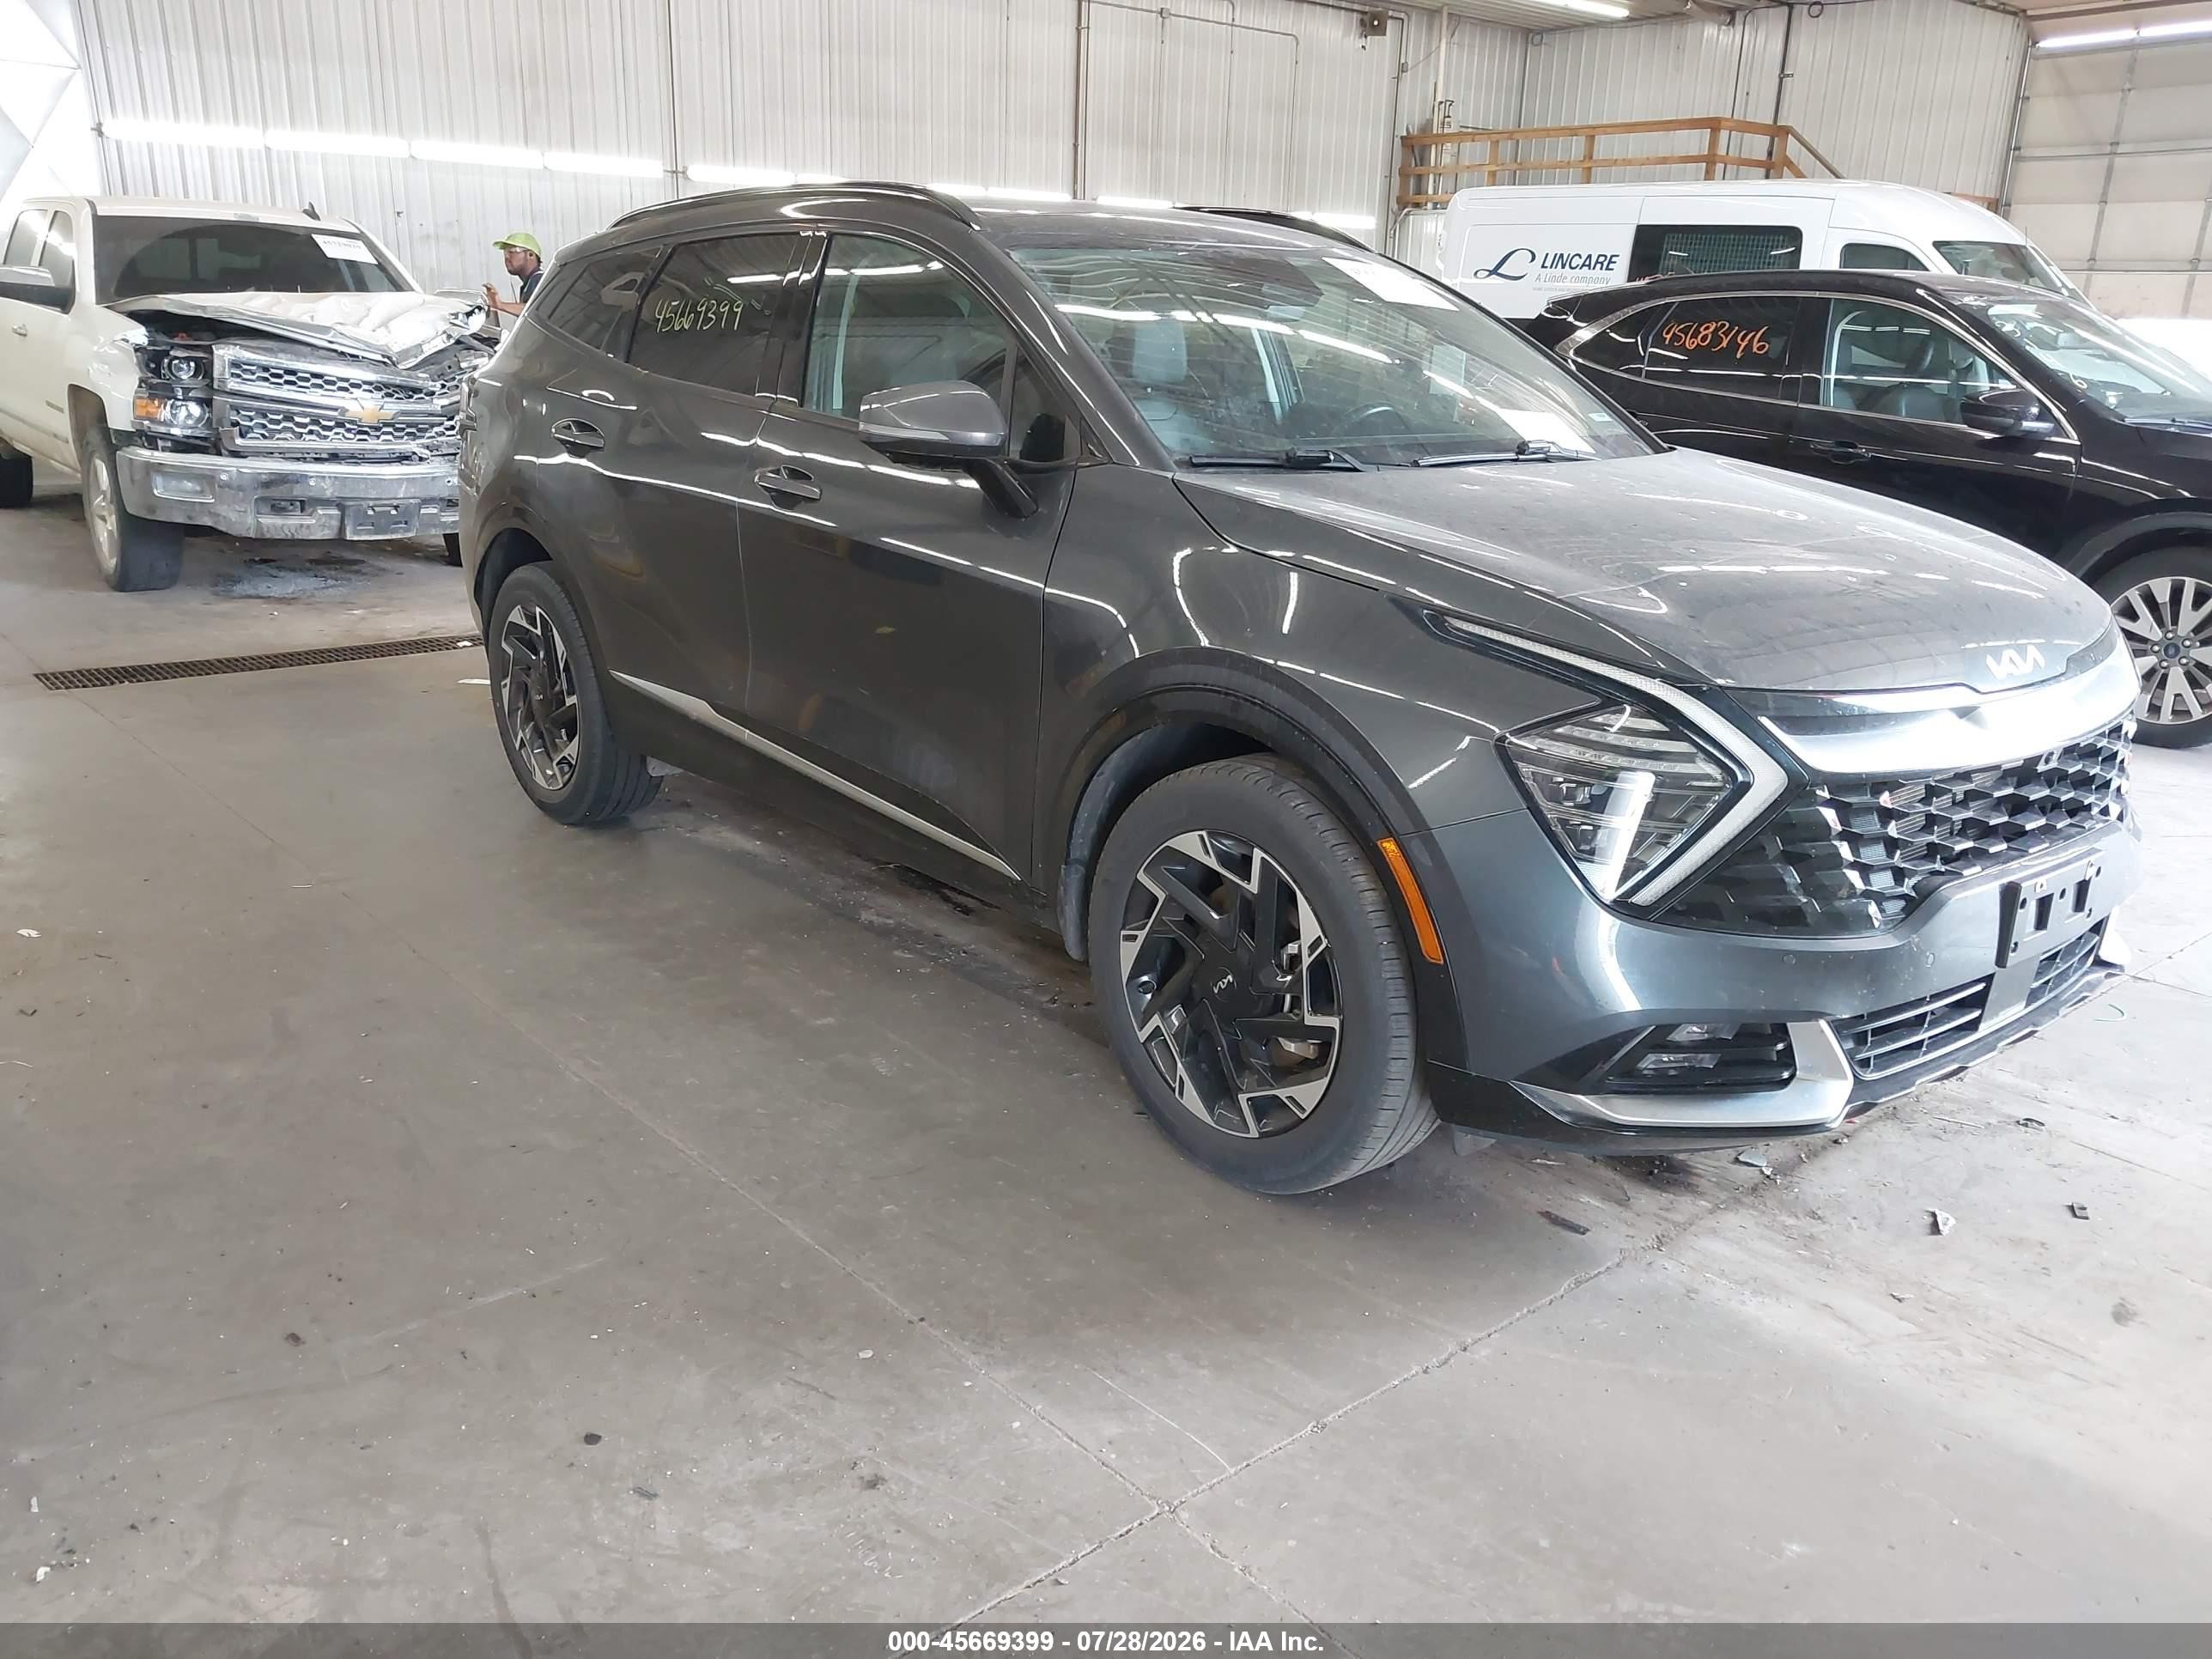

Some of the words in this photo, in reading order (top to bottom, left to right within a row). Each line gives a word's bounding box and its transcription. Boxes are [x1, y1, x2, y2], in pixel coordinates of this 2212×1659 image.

[1540, 252, 1620, 271] LINCARE
[1534, 273, 1541, 283] A
[1544, 273, 1568, 283] Linde
[1570, 275, 1611, 287] company
[655, 298, 744, 333] 45669399
[1662, 320, 1770, 359] 45683146
